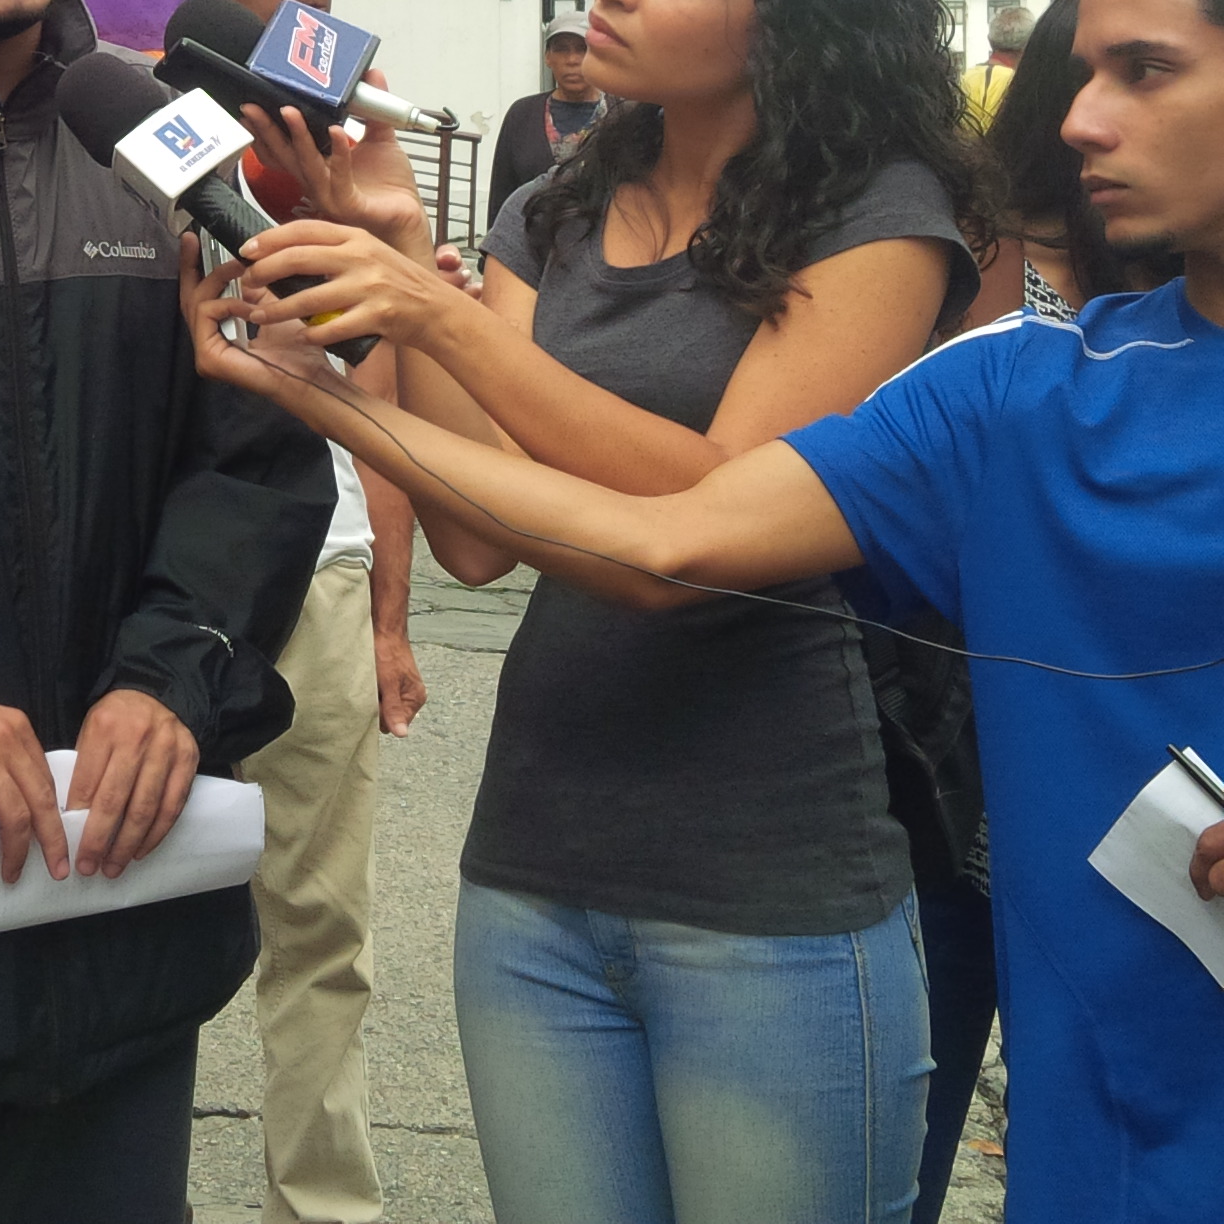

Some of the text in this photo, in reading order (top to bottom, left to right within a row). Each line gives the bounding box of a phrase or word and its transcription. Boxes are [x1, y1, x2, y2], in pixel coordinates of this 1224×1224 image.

[287, 8, 330, 87] FM
[317, 28, 334, 74] center
[98, 240, 155, 259] Columbia
